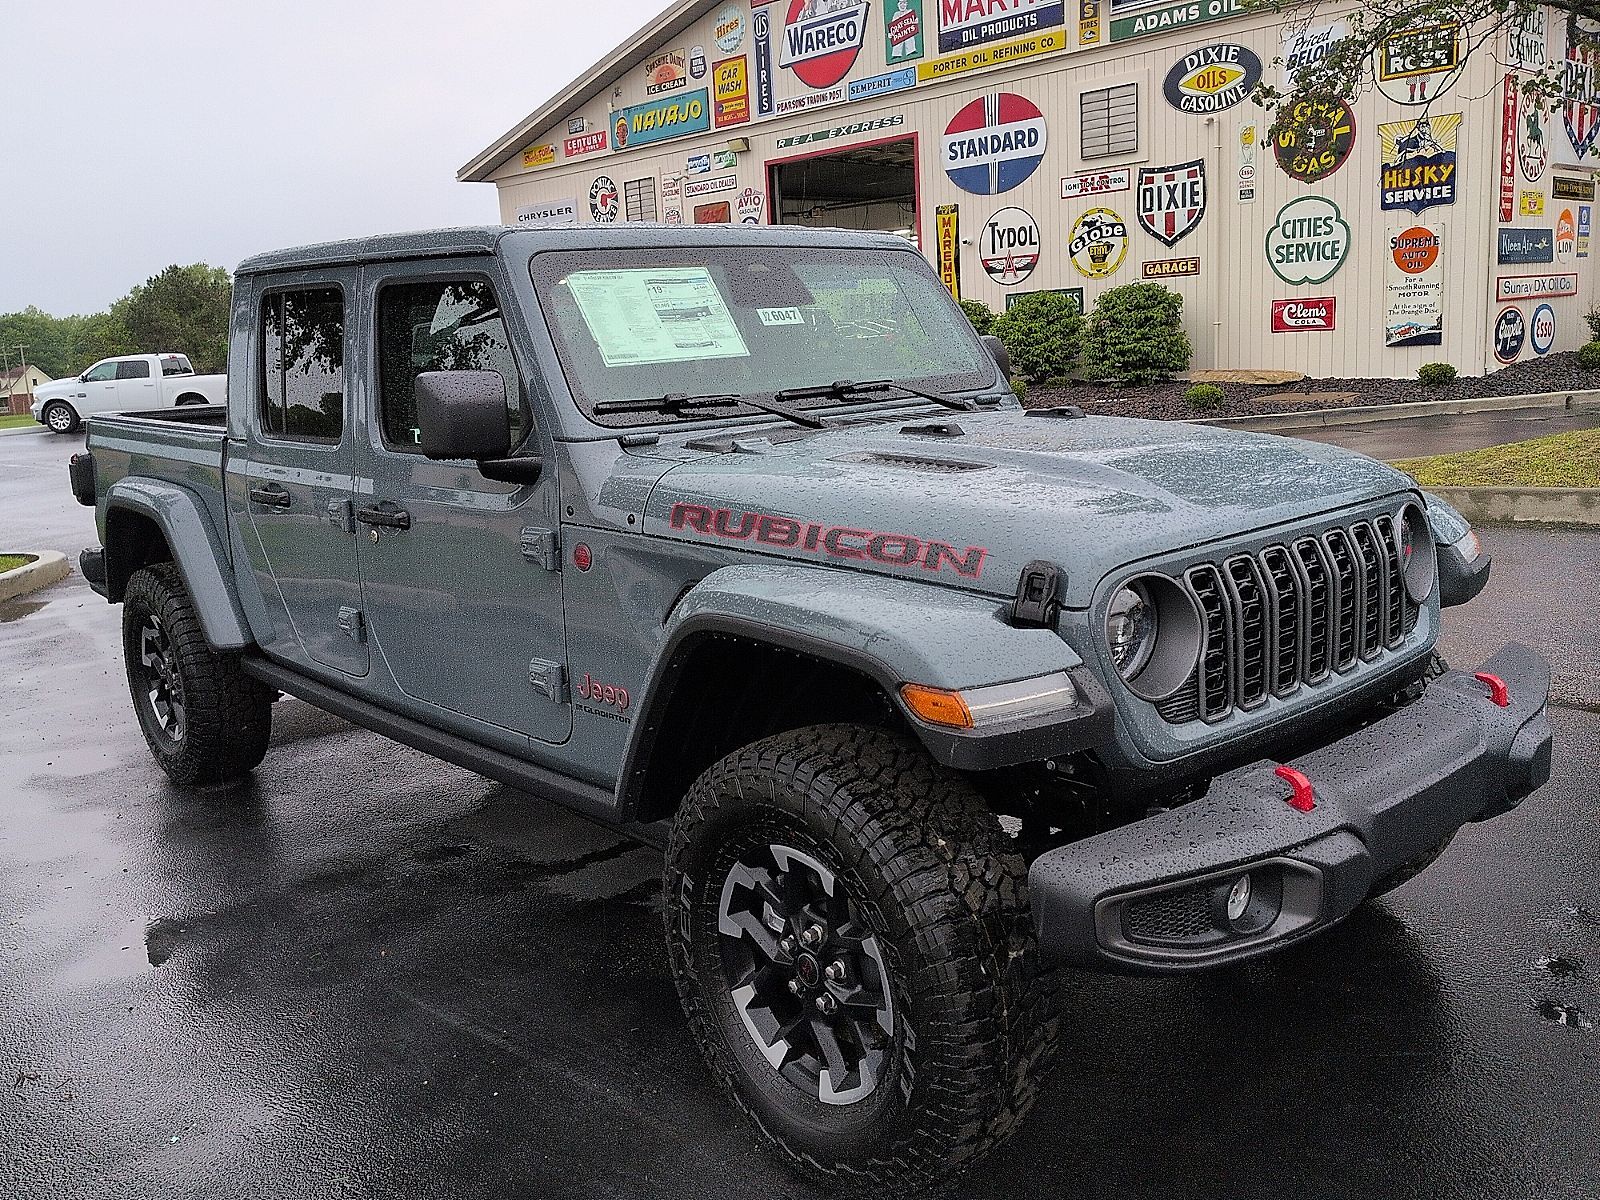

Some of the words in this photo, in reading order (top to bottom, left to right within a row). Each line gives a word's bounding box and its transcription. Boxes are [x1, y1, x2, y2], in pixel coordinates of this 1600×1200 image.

[756, 16, 767, 36] US
[1080, 20, 1098, 30] TIRES
[1133, 5, 1200, 33] ADAMS
[1208, 0, 1243, 16] OIL
[716, 19, 739, 39] Hires
[893, 25, 916, 41] PAINTS
[962, 29, 979, 43] OIL
[981, 13, 1038, 38] PRODUCTS
[787, 20, 857, 57] WARECO
[1291, 26, 1334, 53] Priced
[933, 58, 967, 73] PORTER
[972, 53, 988, 64] OIL
[993, 41, 1036, 60] REFINING
[1041, 37, 1056, 48] CO.
[1184, 45, 1240, 72] DIXIE
[1509, 32, 1546, 66] STAMPS
[721, 68, 738, 81] CAR
[758, 41, 769, 111] TIRES
[1196, 70, 1227, 88] OILS
[648, 85, 660, 94] ICE
[661, 79, 685, 90] CREAM
[718, 80, 742, 95] WASH
[850, 77, 892, 95] SEMPERIT
[806, 93, 828, 106] TRADING
[829, 89, 842, 101] POST
[1180, 82, 1248, 112] GASOLINE
[632, 99, 702, 134] NAVAJO
[828, 115, 903, 138] EXPRESS
[1504, 83, 1515, 174] ATLAS
[567, 133, 603, 150] CENTURY
[948, 127, 1039, 161] STANDARD
[1293, 151, 1336, 174] GAS
[590, 177, 615, 197] PONTIAC
[686, 183, 710, 194] STANDARD
[710, 181, 718, 189] OIL
[719, 178, 735, 188] DEALER
[1065, 181, 1094, 191] IGNITION
[1096, 177, 1126, 187] CONTROL
[1383, 164, 1454, 190] HUSKY
[738, 196, 760, 210] AVIO
[1142, 180, 1200, 213] DIXIE
[1385, 185, 1452, 204] SERVICE
[518, 207, 573, 222] CHRYSLER
[738, 206, 760, 215] GASOLINE
[1281, 215, 1334, 239] CITIES
[988, 222, 1038, 254] TYDOL
[1071, 224, 1124, 253] Globe
[1390, 236, 1440, 250] SUPREME
[1558, 241, 1573, 254] LION
[1275, 240, 1340, 264] SERVICE
[1402, 250, 1428, 260] AUTO
[1145, 260, 1197, 275] GARAGE
[1406, 261, 1424, 269] OIL
[1413, 282, 1440, 290] Running
[1503, 281, 1533, 295] Sunray
[1534, 279, 1547, 292] DX
[1548, 278, 1559, 290] Oil
[1560, 278, 1572, 290] Co.
[1283, 303, 1327, 320] Clem's
[669, 501, 989, 579] RUBICON
[576, 671, 630, 714] Jeep
[583, 705, 631, 725] GLADIATOR
